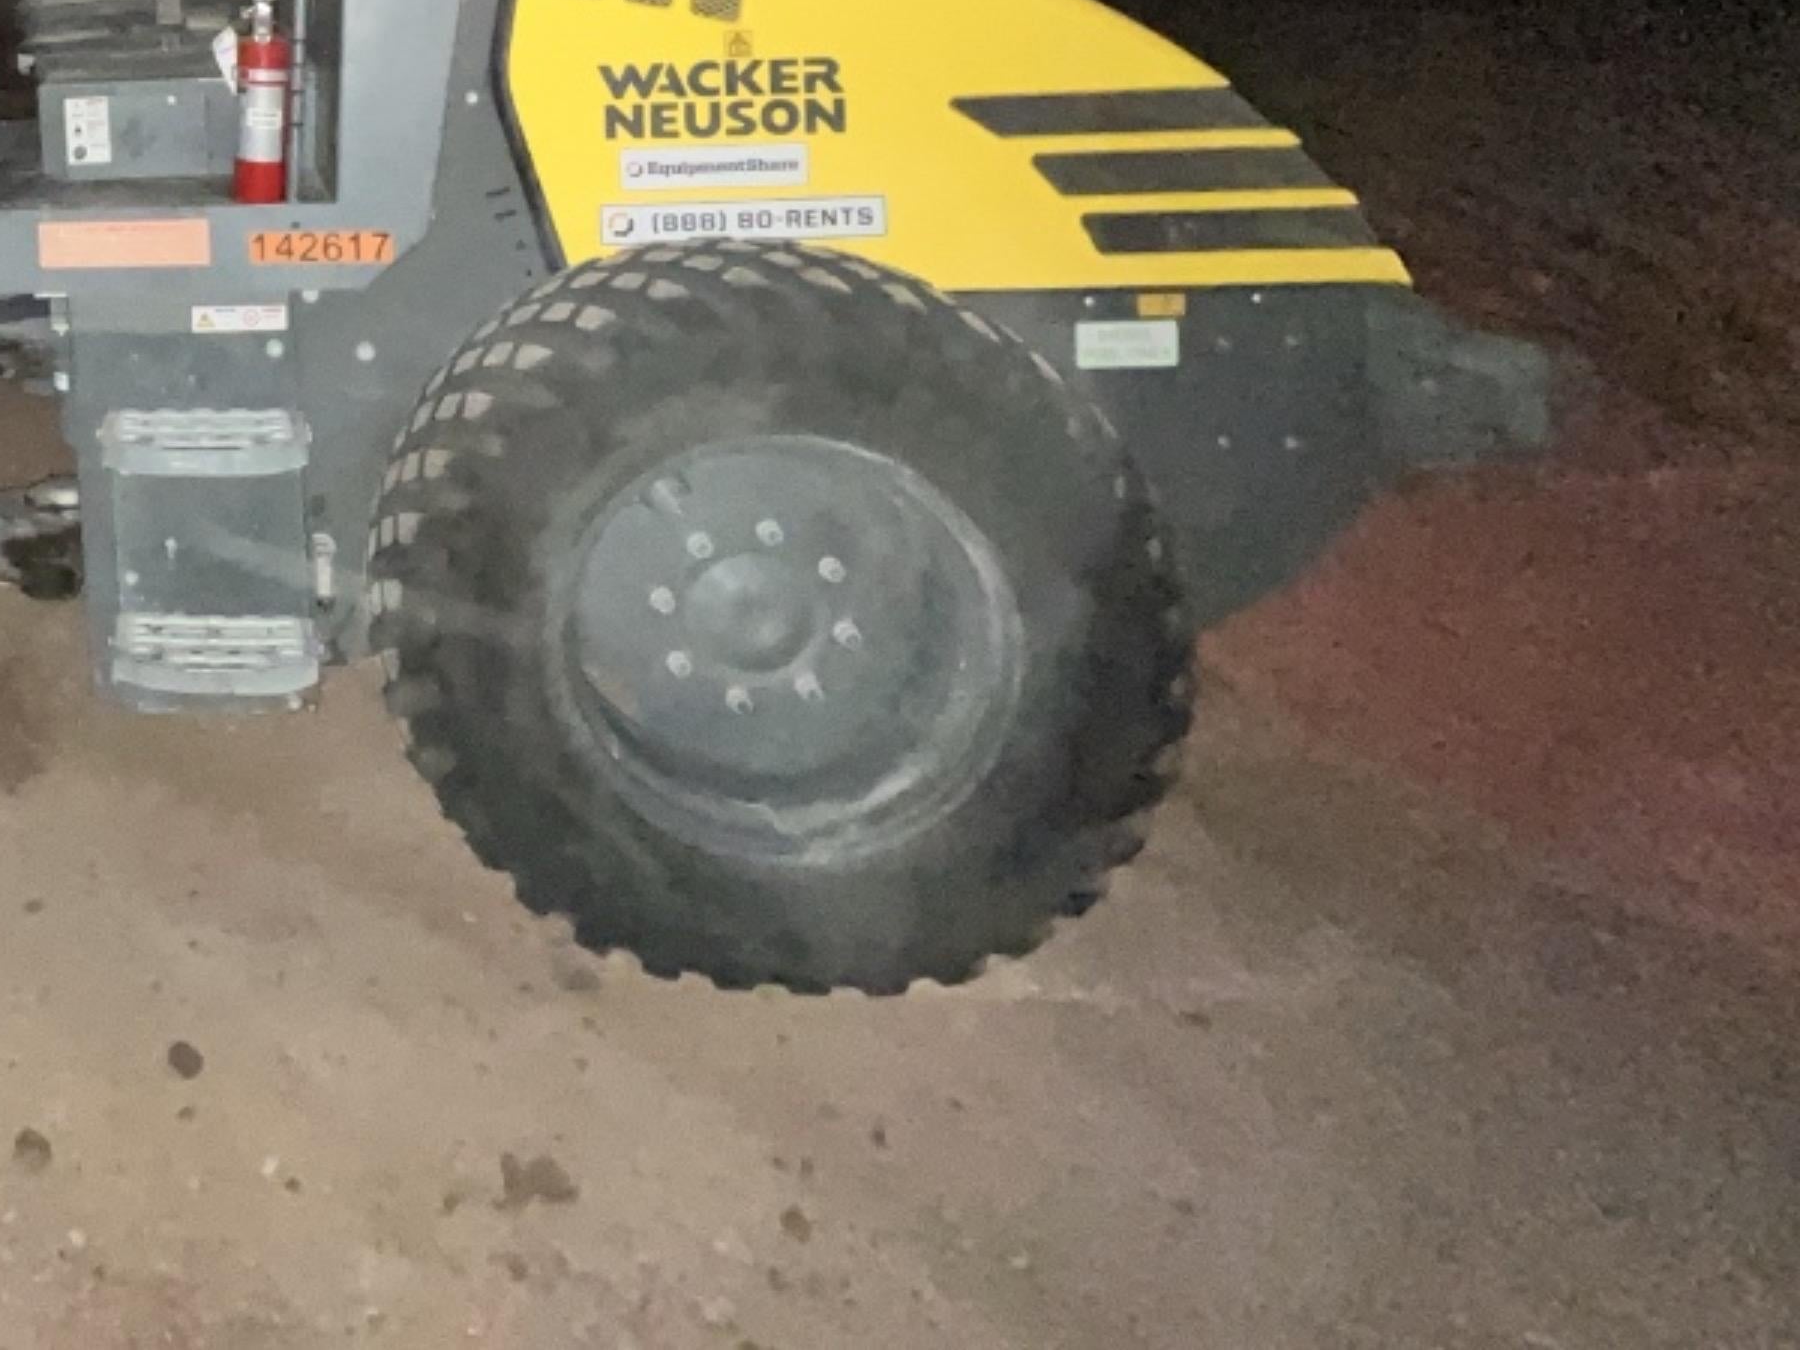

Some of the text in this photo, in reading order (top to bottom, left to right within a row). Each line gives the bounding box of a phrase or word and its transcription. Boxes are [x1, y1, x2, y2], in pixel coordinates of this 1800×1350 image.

[597, 57, 844, 99] WACKER
[604, 98, 846, 139] NEUSON
[647, 158, 800, 177] EquipmentShare
[651, 206, 875, 235] (888) 80-RENTS
[252, 232, 391, 262] 142617
